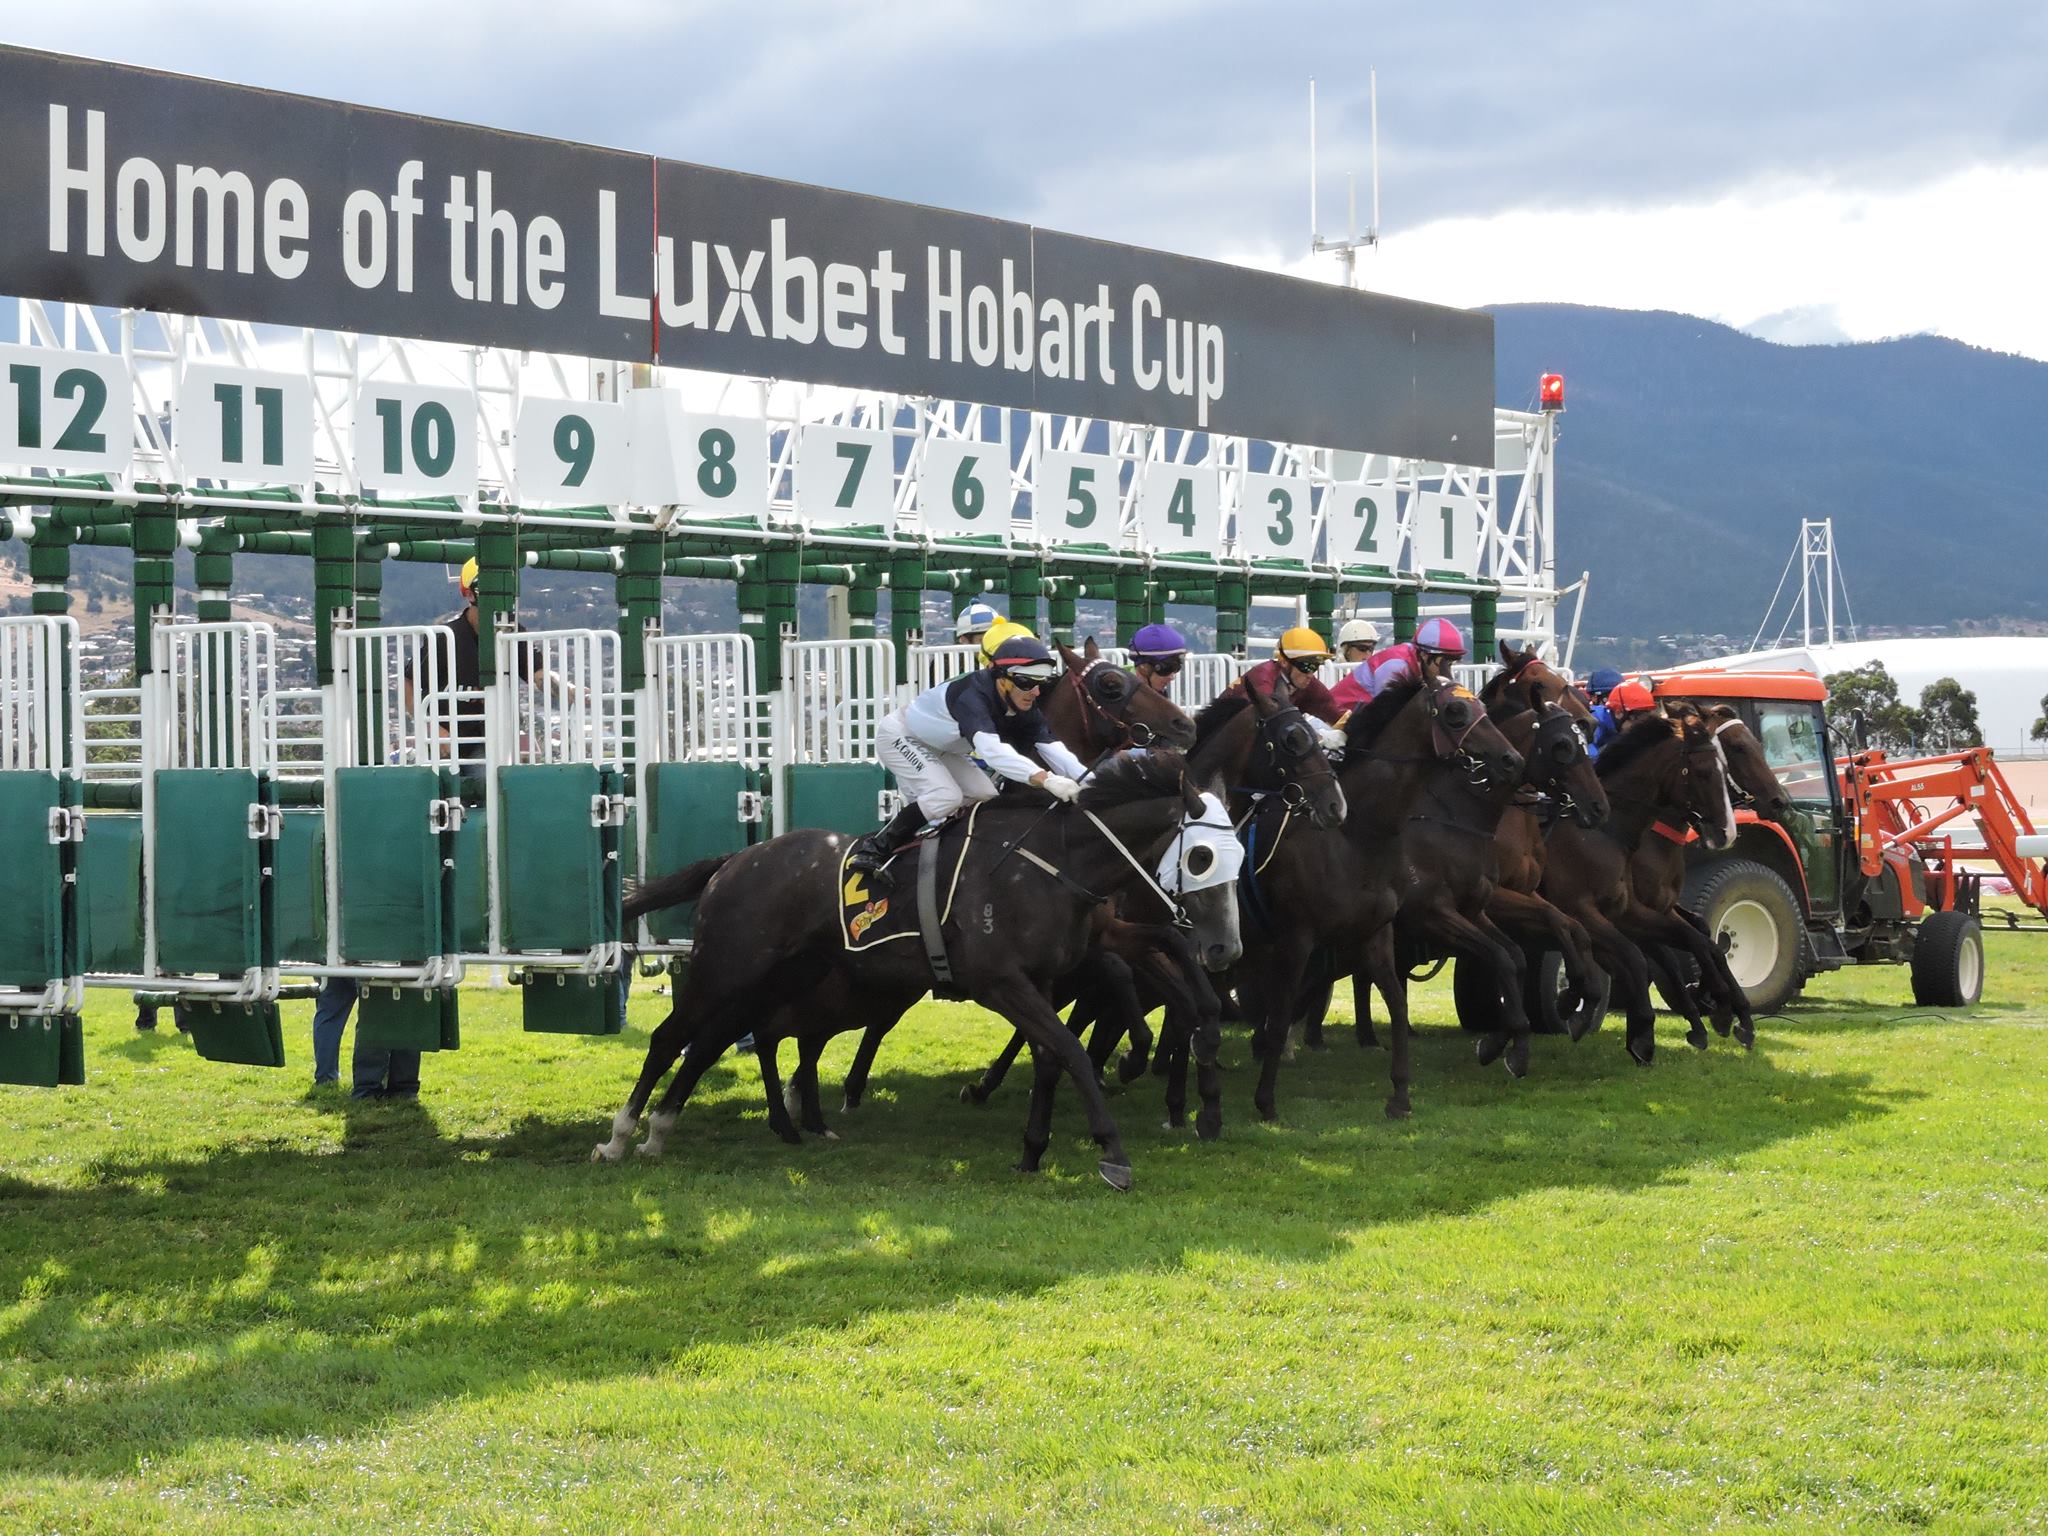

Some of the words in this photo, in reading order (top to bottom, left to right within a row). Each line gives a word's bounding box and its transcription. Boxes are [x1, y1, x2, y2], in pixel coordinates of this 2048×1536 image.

[49, 103, 310, 280] Home
[342, 159, 424, 293] of
[444, 169, 566, 310] the
[598, 189, 907, 356] Luxbet
[927, 245, 1116, 386] Hobart
[1131, 283, 1225, 427] Cup
[9, 363, 107, 454] 12
[214, 383, 284, 466] 11
[375, 398, 456, 478] 10
[553, 414, 595, 487] 9
[697, 428, 737, 499] 8
[835, 442, 873, 508] 7
[952, 455, 985, 520] 6
[1065, 466, 1097, 529] 5
[1167, 478, 1196, 537] 4
[1267, 488, 1294, 546] 3
[1354, 497, 1378, 553] 2
[1440, 506, 1453, 560] 1
